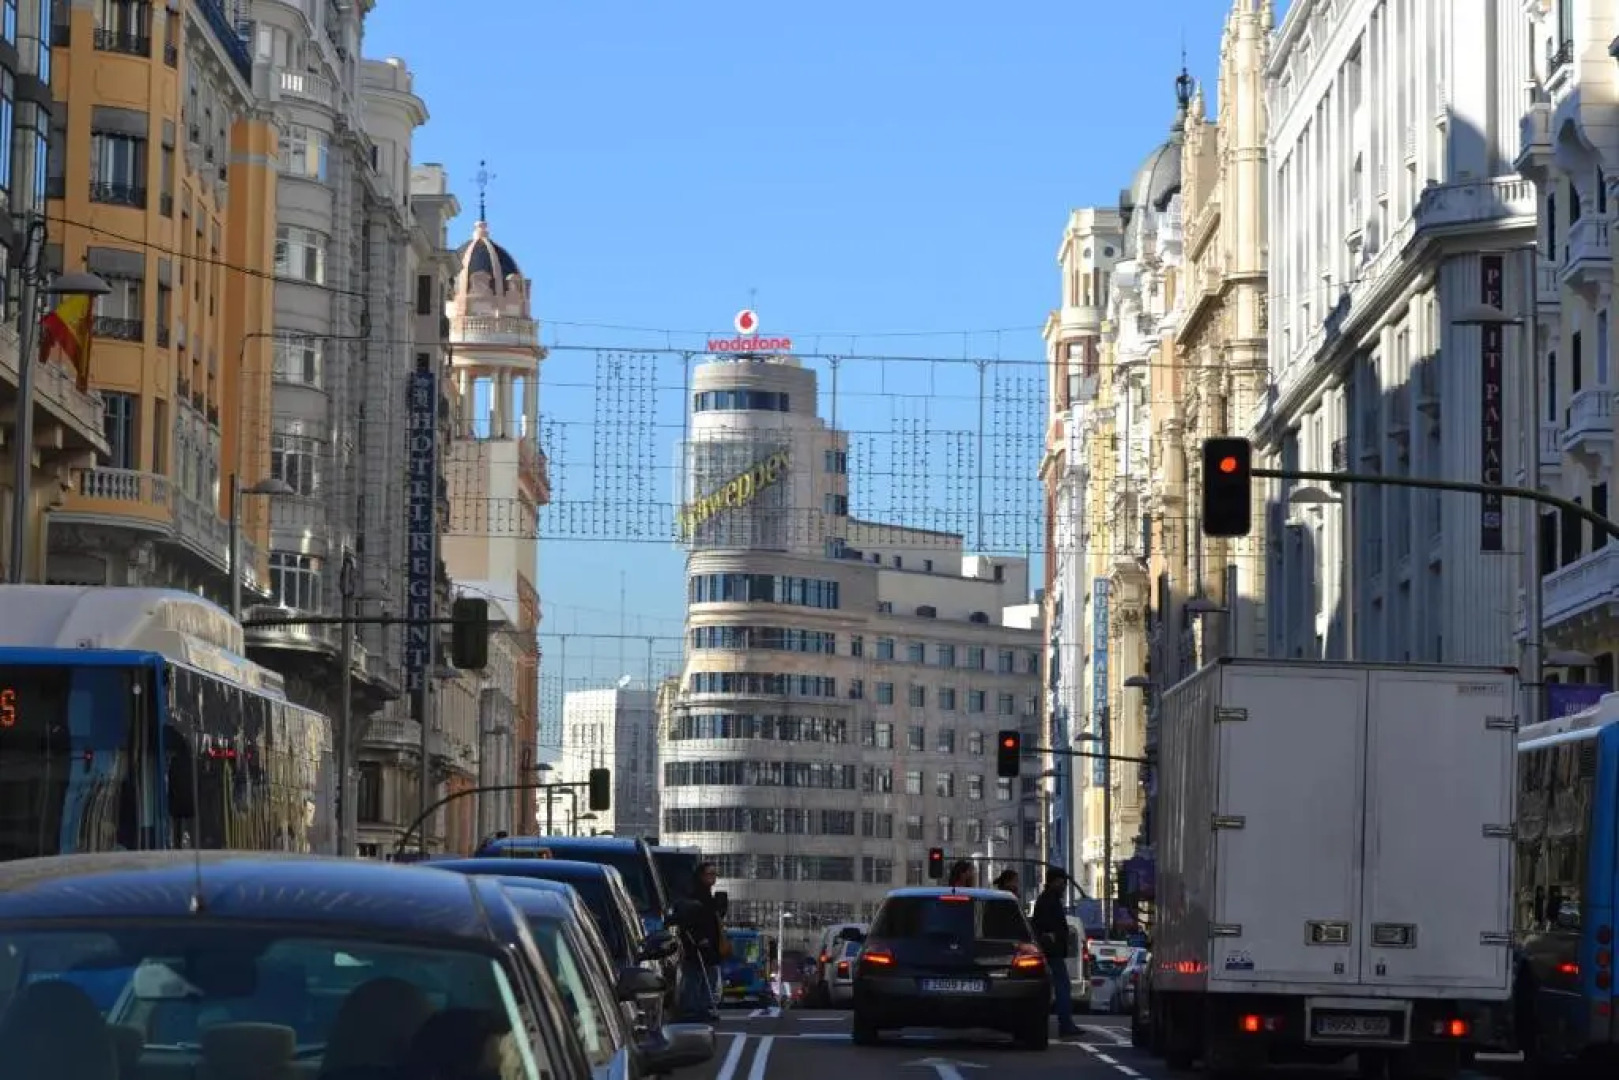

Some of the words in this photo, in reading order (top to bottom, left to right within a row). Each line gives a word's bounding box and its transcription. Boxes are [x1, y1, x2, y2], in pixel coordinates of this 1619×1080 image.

[708, 334, 791, 351] vodafone
[1485, 269, 1500, 368] PEIT
[410, 412, 431, 521] HOTEL
[409, 533, 428, 689] REGENTE
[1096, 580, 1106, 649] HOTEL
